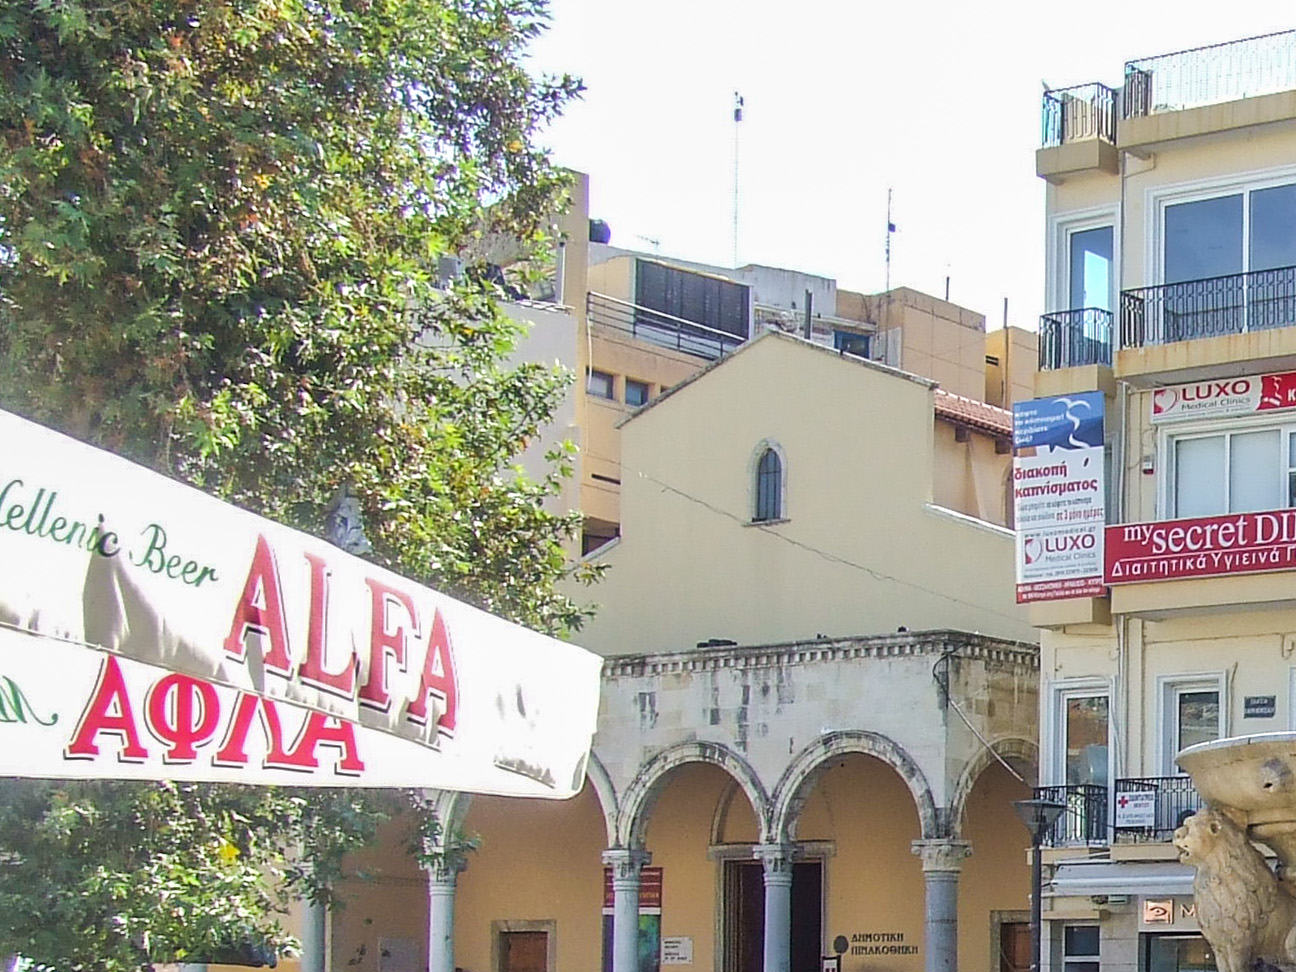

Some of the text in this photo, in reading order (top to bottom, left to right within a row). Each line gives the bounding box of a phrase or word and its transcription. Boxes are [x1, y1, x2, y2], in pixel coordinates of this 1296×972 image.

[1181, 379, 1251, 402] LUXO
[1181, 396, 1251, 412] Medical Clinics
[1014, 460, 1068, 481] διακοπή
[1014, 479, 1099, 499] καπνίσματος
[1045, 533, 1096, 552] LUXO
[129, 523, 219, 588] Beer
[1045, 551, 1097, 561] Medical Clinics
[1111, 552, 1207, 577] Διαιτητικά
[1210, 546, 1280, 570] Υγιεινά
[222, 532, 460, 738] ALFA
[851, 933, 904, 943] ΔΗΜΟΤΙΚΗ
[851, 945, 919, 956] ΠΙΝΑΚΟΘΗΚΗ
